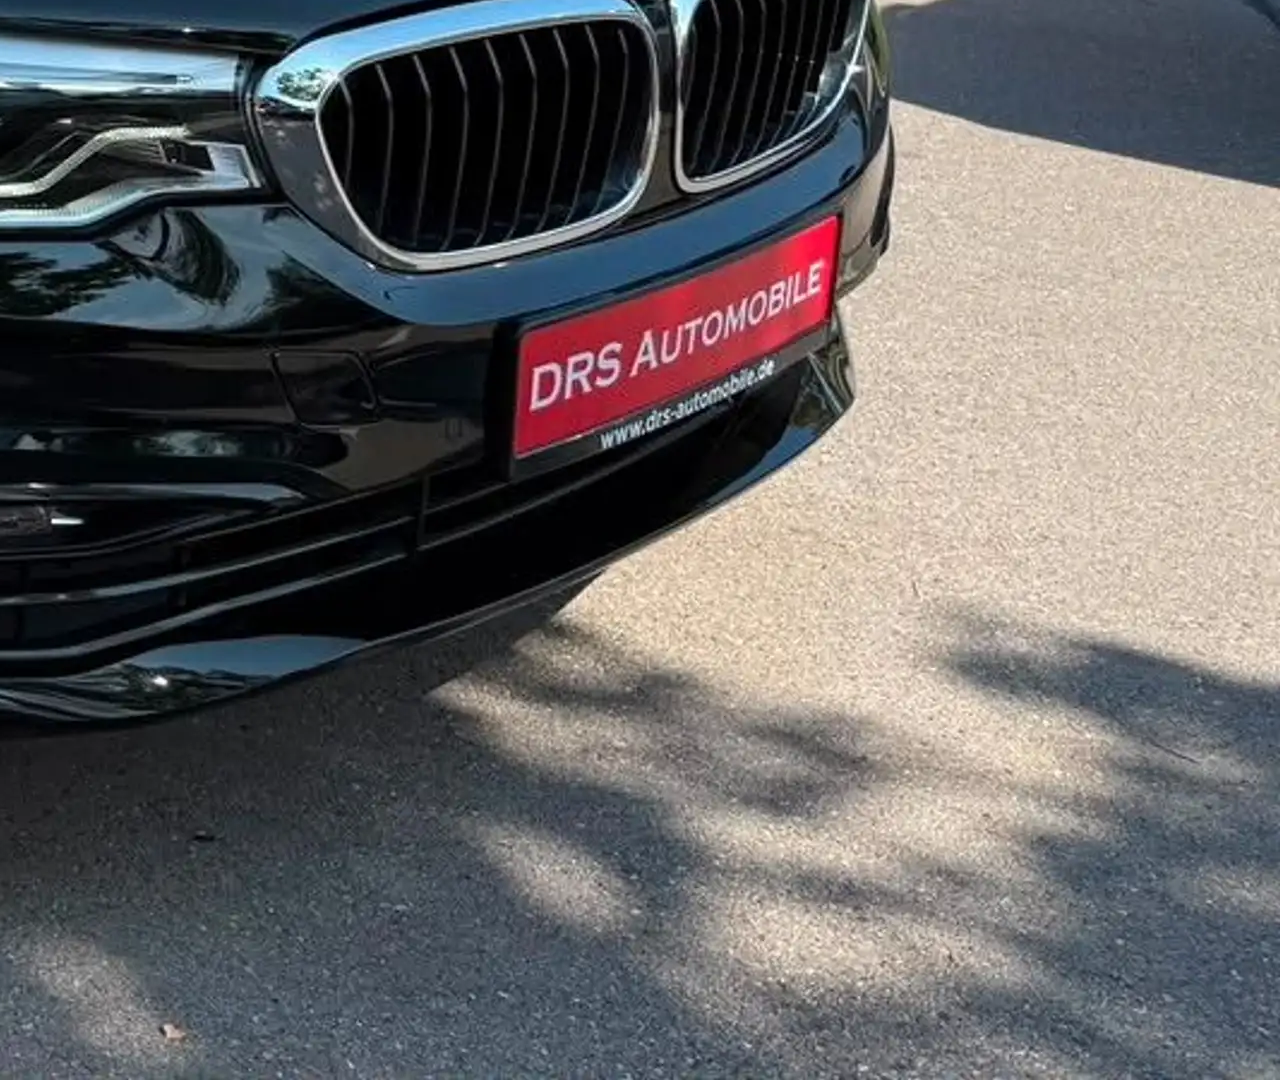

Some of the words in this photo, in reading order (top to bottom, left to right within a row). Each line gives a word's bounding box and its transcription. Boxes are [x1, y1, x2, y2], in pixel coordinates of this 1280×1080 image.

[529, 340, 624, 412] DRS
[629, 260, 825, 378] AUTOMOBILE
[600, 358, 775, 450] www.drs-automobile.de
